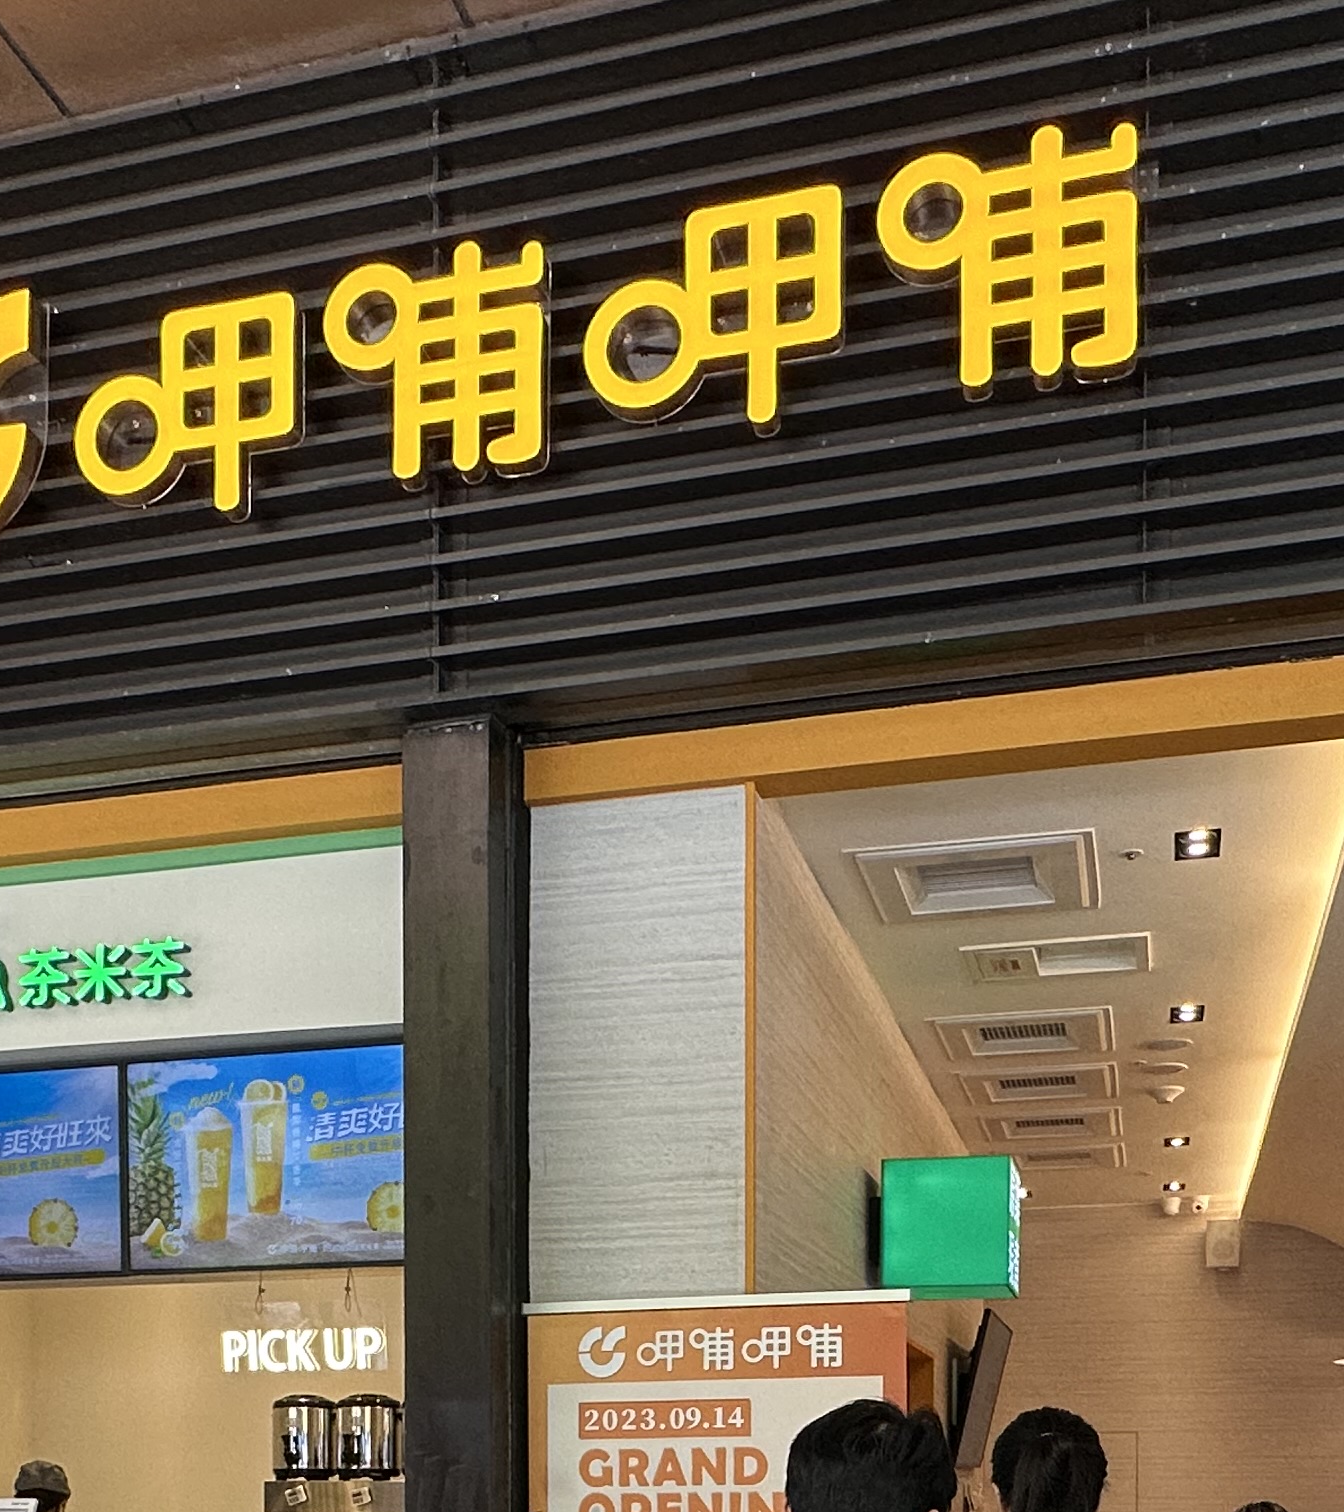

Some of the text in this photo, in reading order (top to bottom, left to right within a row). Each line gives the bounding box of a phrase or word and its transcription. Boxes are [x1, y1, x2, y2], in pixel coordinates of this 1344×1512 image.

[74, 122, 1140, 513] 呷哺呷哺
[18, 936, 189, 1007] 茶米茶
[305, 1102, 404, 1142] 清爽好
[221, 1326, 386, 1373] PICK UP
[636, 1323, 844, 1371] 呷哺呷哺
[583, 1406, 746, 1432] 2023.09.14
[578, 1446, 769, 1488] GRAND
